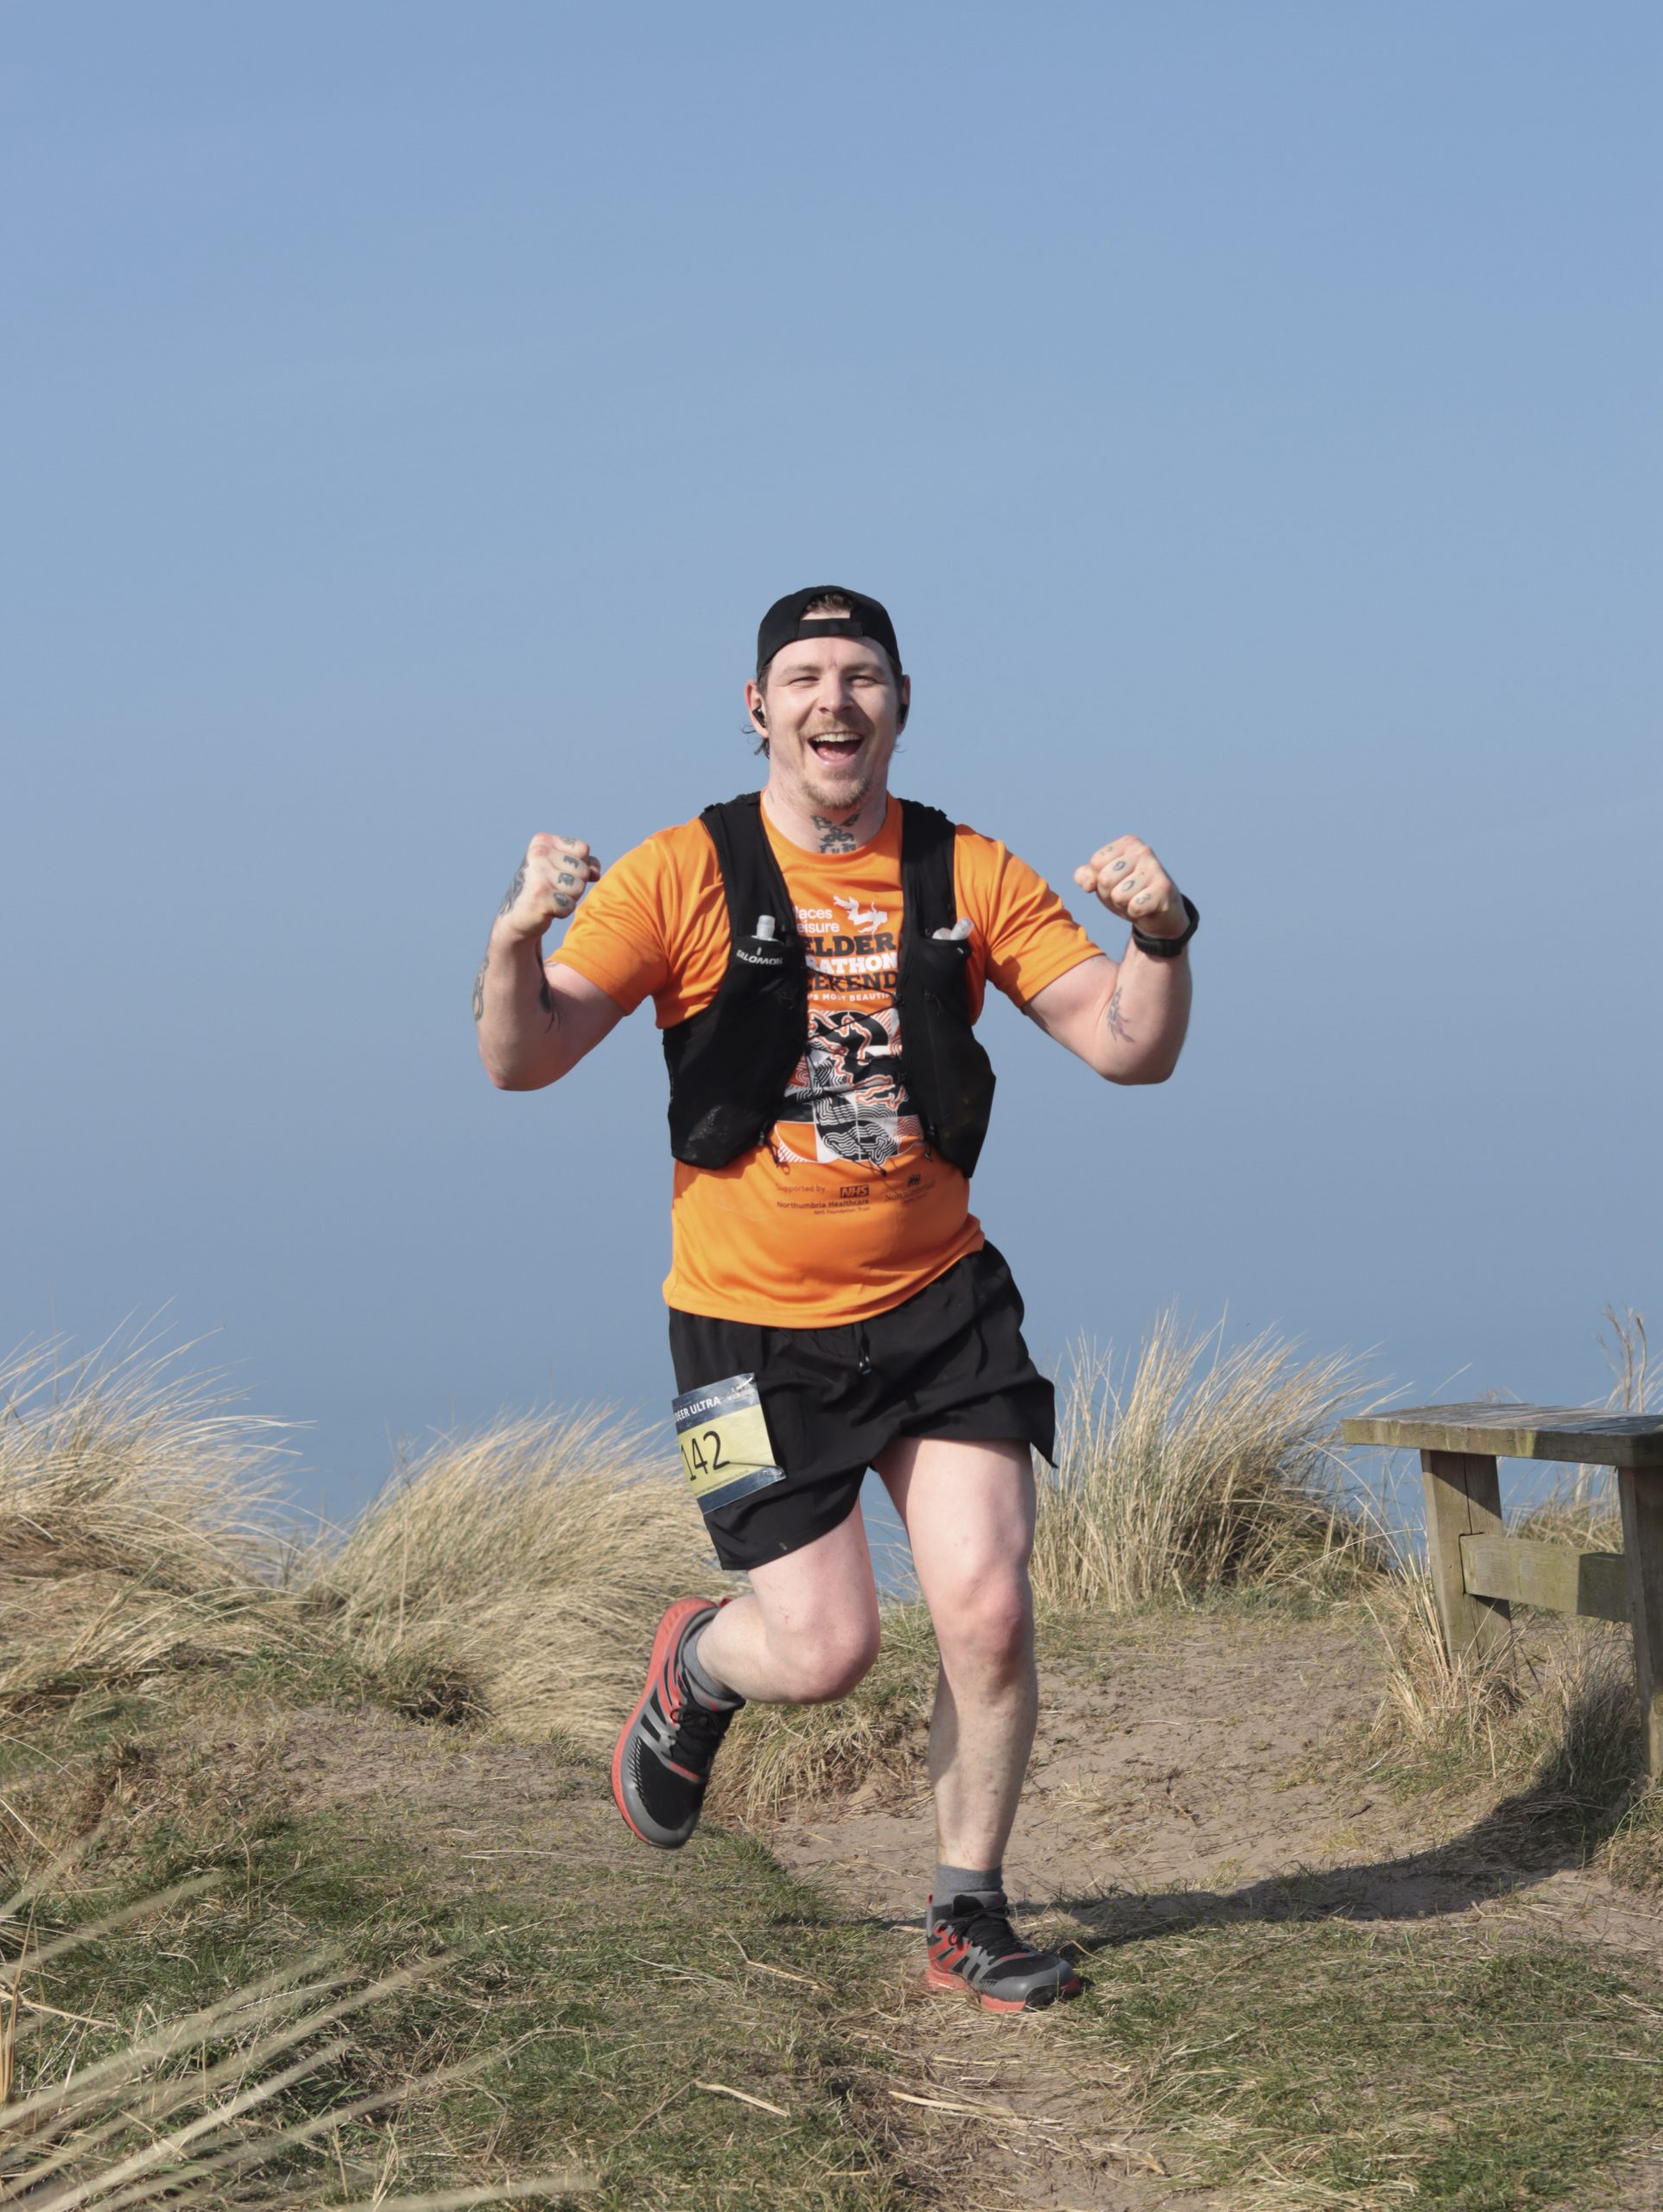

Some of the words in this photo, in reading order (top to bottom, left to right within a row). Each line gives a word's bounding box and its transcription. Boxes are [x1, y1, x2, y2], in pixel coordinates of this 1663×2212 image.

[736, 949, 784, 965] SALOMON
[808, 971, 898, 992] EKEND
[841, 1184, 869, 1198] NHS
[777, 1201, 827, 1210] Northumbria
[828, 1198, 870, 1208] Healthcare
[689, 1395, 721, 1414] ULTRA
[681, 1430, 731, 1481] 142
